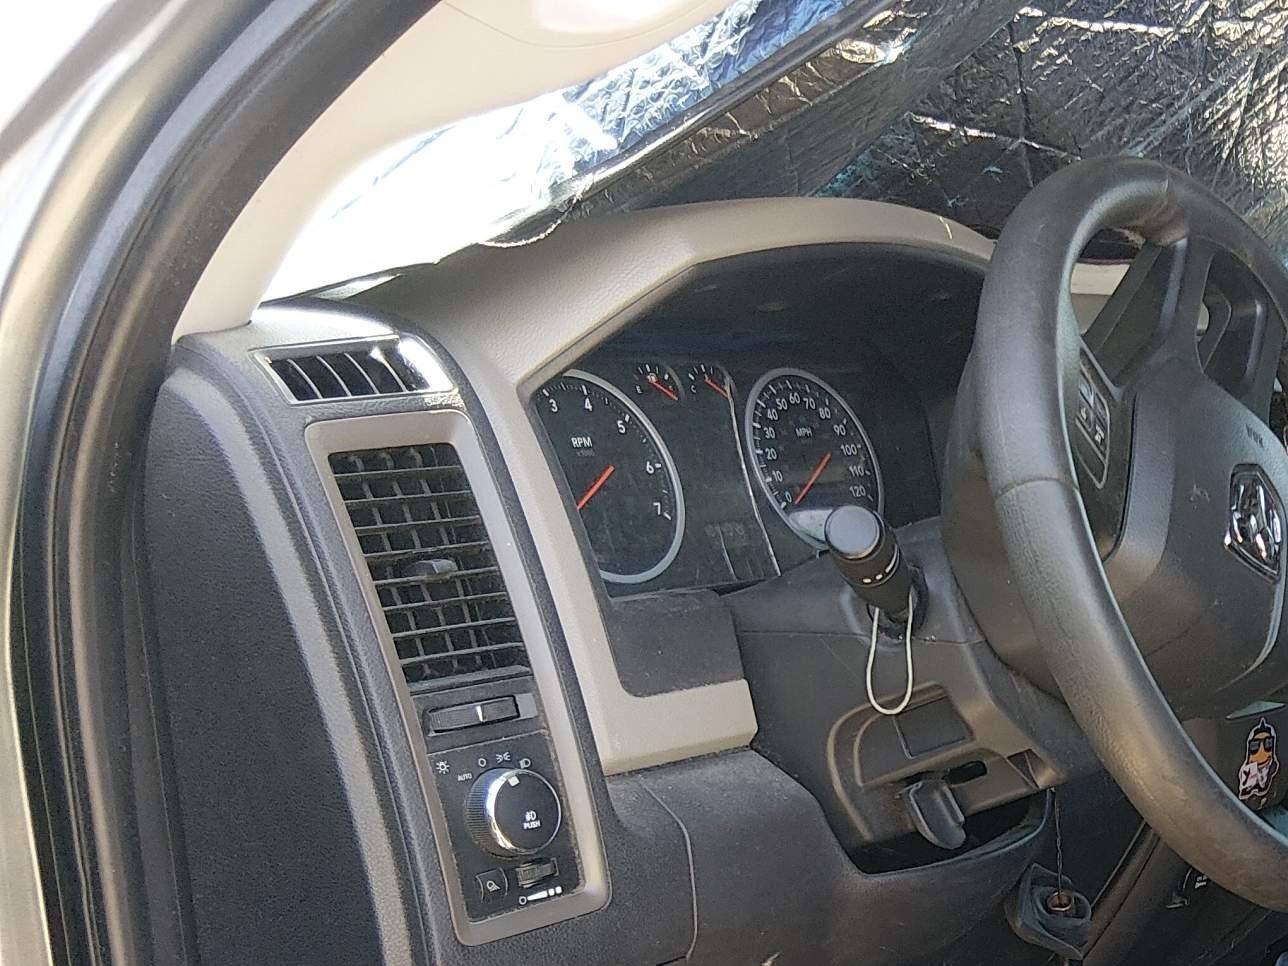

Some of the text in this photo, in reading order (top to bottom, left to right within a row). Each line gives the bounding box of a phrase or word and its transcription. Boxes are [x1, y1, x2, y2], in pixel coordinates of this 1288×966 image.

[776, 398, 788, 410] 50
[789, 392, 800, 404] 60
[803, 398, 816, 410] 70
[548, 399, 558, 412] 3
[584, 398, 592, 412] 4
[767, 408, 778, 420] 40
[819, 408, 831, 419] 80
[616, 420, 626, 434] 5
[795, 427, 812, 437] MPH
[834, 424, 846, 436] 90
[764, 428, 776, 440] 30
[571, 436, 593, 448] RPM
[765, 448, 776, 460] 20
[840, 444, 858, 456] 100
[646, 461, 655, 474] 6
[848, 466, 864, 476] 110
[772, 470, 783, 482] 10
[850, 486, 866, 497] 120
[653, 502, 662, 516] 7
[458, 772, 472, 782] AUTO
[524, 821, 540, 830] PUSH
